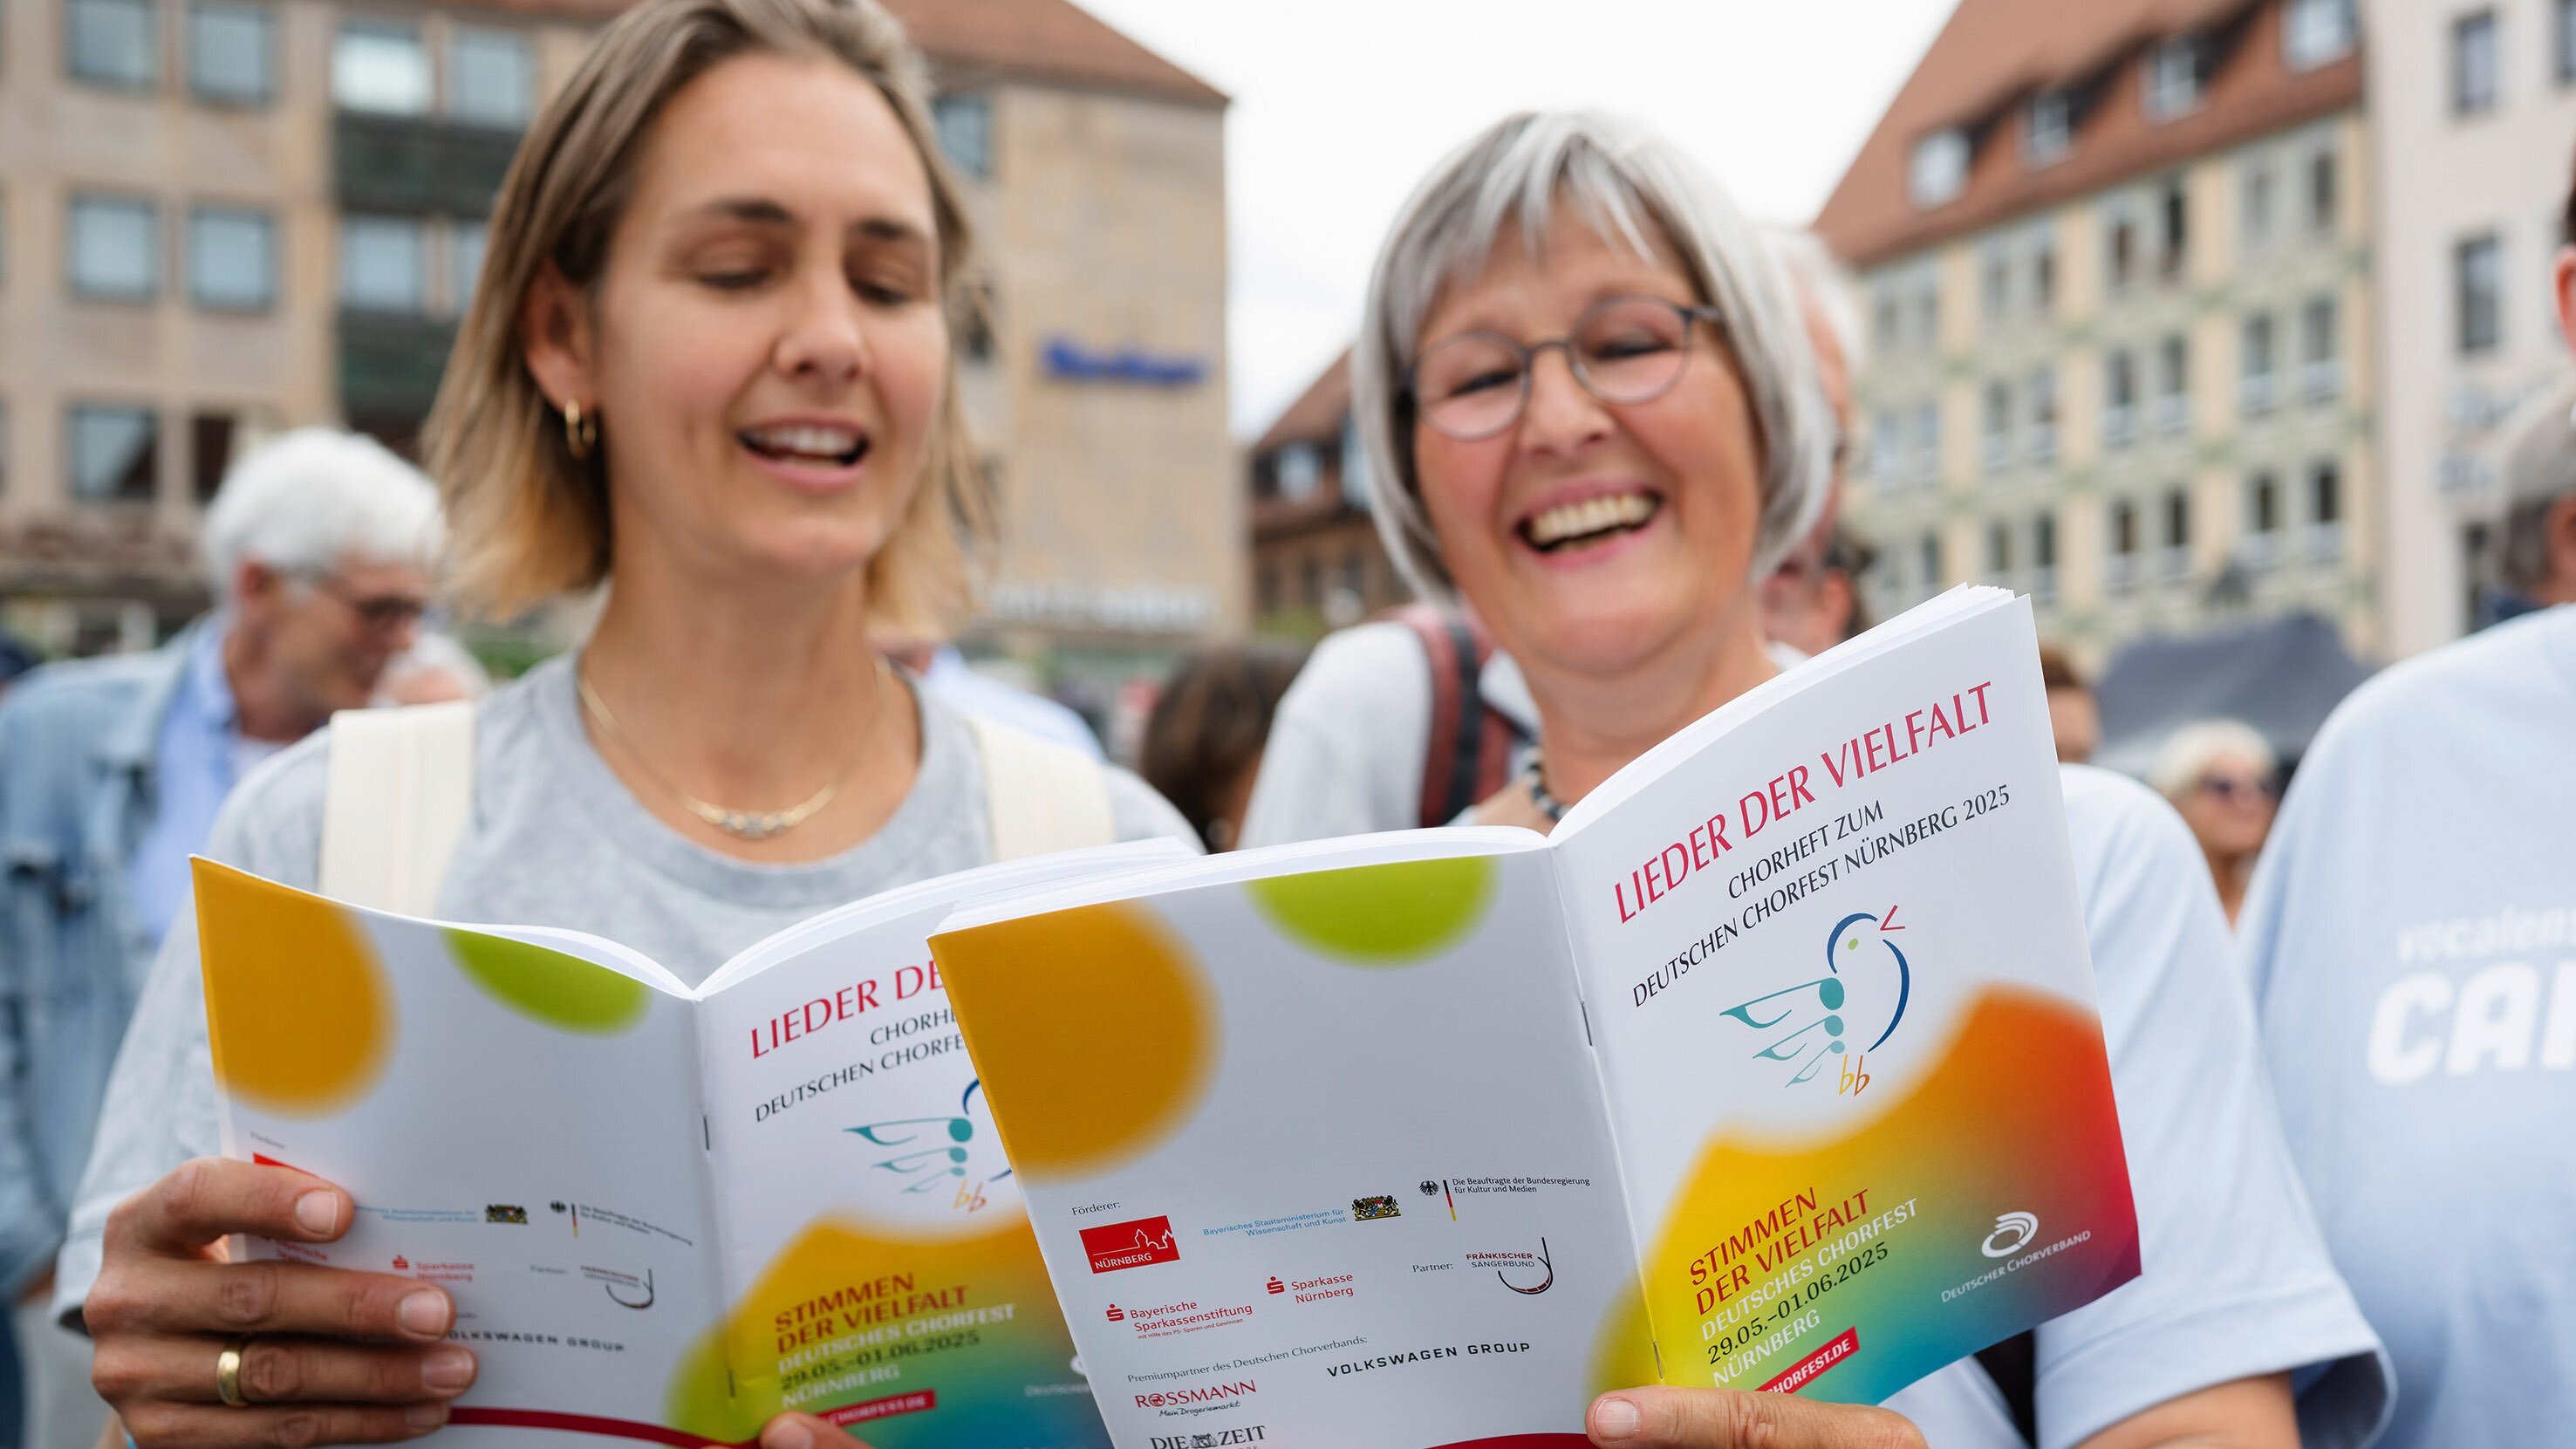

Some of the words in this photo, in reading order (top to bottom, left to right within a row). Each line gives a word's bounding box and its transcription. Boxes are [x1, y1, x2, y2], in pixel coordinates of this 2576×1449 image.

[1614, 814, 1732, 925] LIEDER
[1739, 765, 1815, 838] DER
[1821, 681, 1992, 787] VIELFALT
[1728, 824, 1829, 899] CHORHEFT
[1835, 800, 1883, 840] ZUM
[1632, 918, 1738, 1008] DEUTSCHEN
[1743, 858, 1838, 930] CHORFEST
[1845, 806, 1958, 873] NÜRNBERG
[1964, 784, 2010, 821] 2025
[751, 980, 880, 1059] LIEDER
[755, 1059, 874, 1123] DEUTSCHEN
[1467, 1178, 1511, 1186] Beauftragte
[1527, 1177, 1590, 1186] Bundesregierung
[1071, 1200, 1121, 1216] Förderer:
[1203, 1222, 1254, 1236] Bayerisches
[1254, 1212, 1330, 1227] Staatsministerium
[1246, 1222, 1303, 1236] Wissenschaft
[1322, 1216, 1347, 1226] Kunst
[1689, 1186, 1817, 1286] STIMMEN
[1095, 1253, 1152, 1270] NÜRNBERG
[1412, 1262, 1454, 1274] Partner:
[1466, 1252, 1534, 1261] FRÄNKISCHER
[1696, 1263, 1751, 1316] DER
[1755, 1188, 1869, 1275] VIELFALT
[1291, 1273, 1353, 1291] Sparkasse
[1701, 1258, 1813, 1341] DEUTSCHES
[1818, 1198, 1917, 1265] CHORFEST
[775, 1271, 915, 1334] STIMMEN
[1130, 1302, 1198, 1319] Bayerische
[1295, 1286, 1354, 1303] Nürnberg
[777, 1320, 835, 1355] DER
[842, 1285, 968, 1329] VIELFALT
[1134, 1305, 1253, 1332] Sparkassenstiftung
[567, 1337, 625, 1351] GROUP
[777, 1328, 901, 1375] DEUTSCHES
[905, 1302, 1015, 1338] CHORFEST
[1713, 1309, 1821, 1387] NÜRNBERG
[1127, 1367, 1210, 1384] Premiumpartner
[1213, 1363, 1231, 1372] des
[1233, 1350, 1288, 1368] Deutschen
[1291, 1336, 1369, 1357] Chorverbands:
[1327, 1347, 1458, 1377] VOLKSWAGEN
[1467, 1342, 1531, 1355] GROUP
[782, 1363, 900, 1408] NÜRNBERG
[1135, 1379, 1257, 1408] ROSSMANN
[1179, 1400, 1241, 1417] Drogeriemarkt
[1150, 1435, 1189, 1449] DIE
[1218, 1425, 1267, 1446] ZEIT
